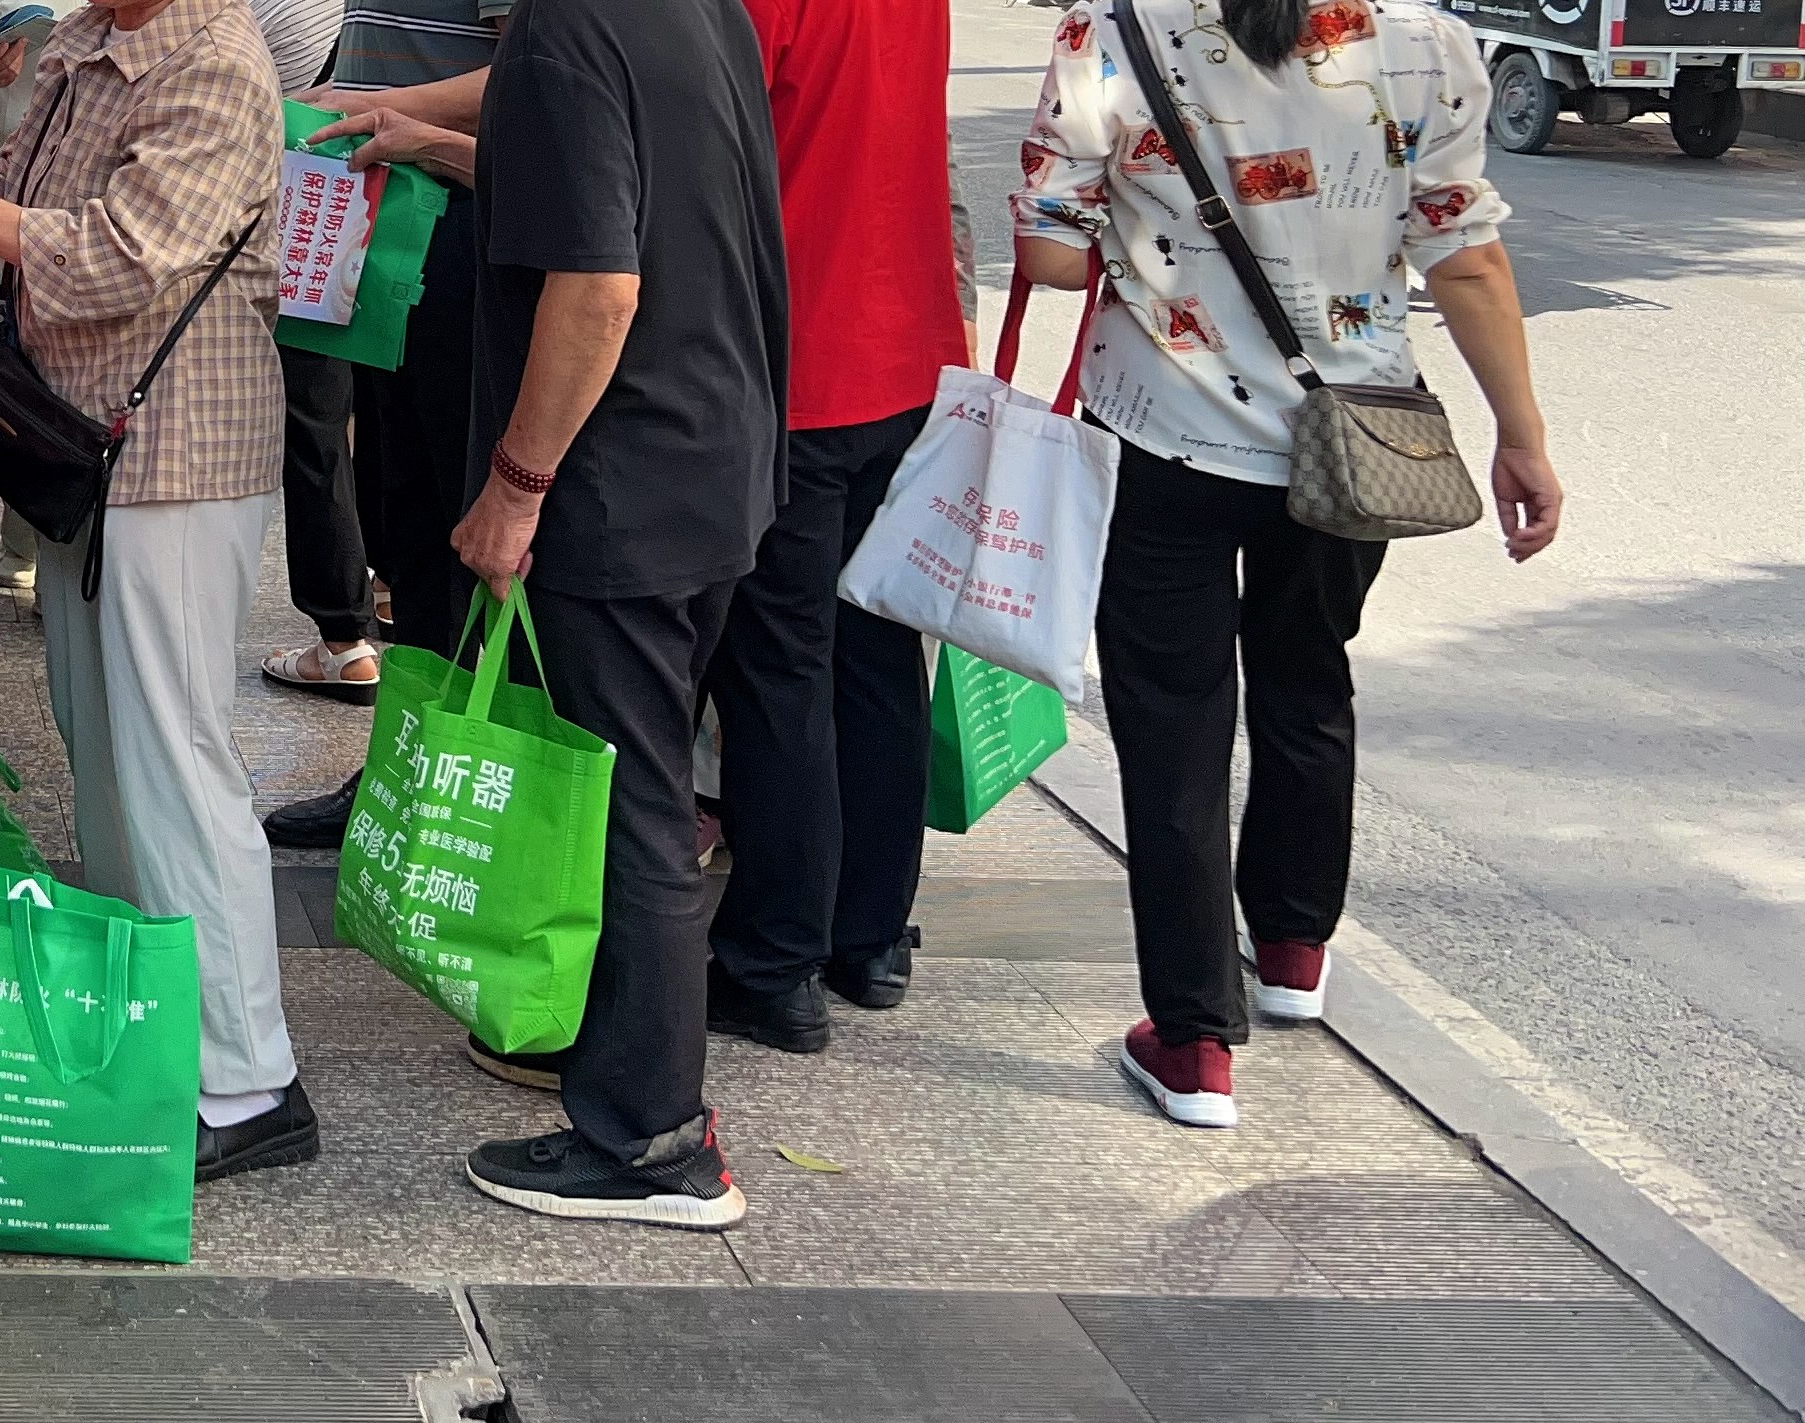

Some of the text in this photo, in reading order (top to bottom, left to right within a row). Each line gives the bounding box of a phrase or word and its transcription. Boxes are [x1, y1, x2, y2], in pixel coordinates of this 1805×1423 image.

[1702, 0, 1763, 13] 顺丰速运
[278, 170, 327, 301] 保护森林靠大家
[303, 176, 356, 306] 森林防火常年抓
[348, 808, 480, 916] 保修5 无烦恼
[418, 827, 493, 863] 专业医学验配
[64, 988, 159, 1024] “十准”
